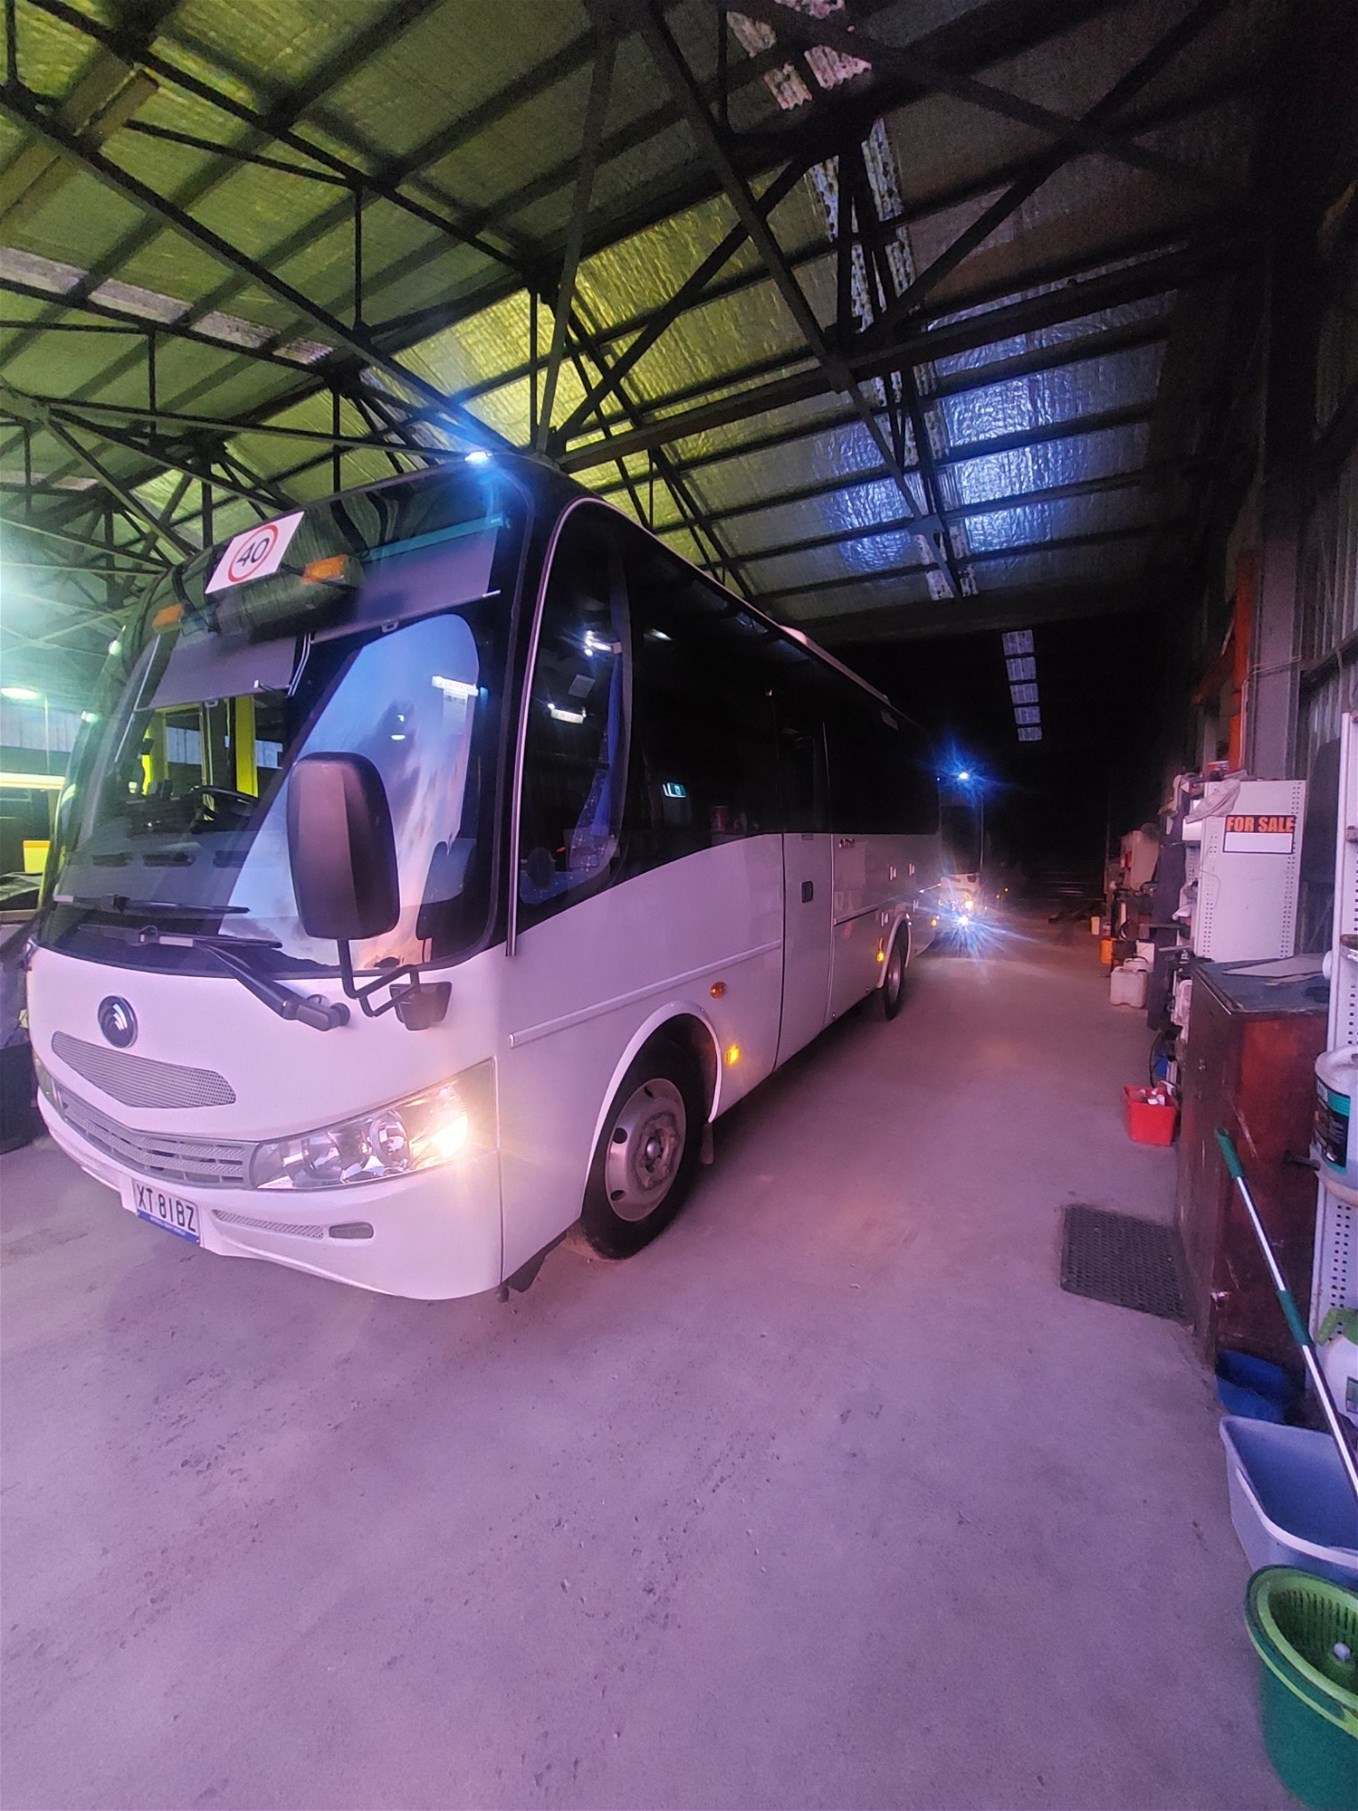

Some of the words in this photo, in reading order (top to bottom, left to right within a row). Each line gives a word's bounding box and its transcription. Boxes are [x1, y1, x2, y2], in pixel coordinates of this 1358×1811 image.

[236, 537, 270, 567] 40
[1226, 816, 1255, 832] FOR
[1257, 816, 1294, 832] SALE
[136, 1183, 153, 1213] XT
